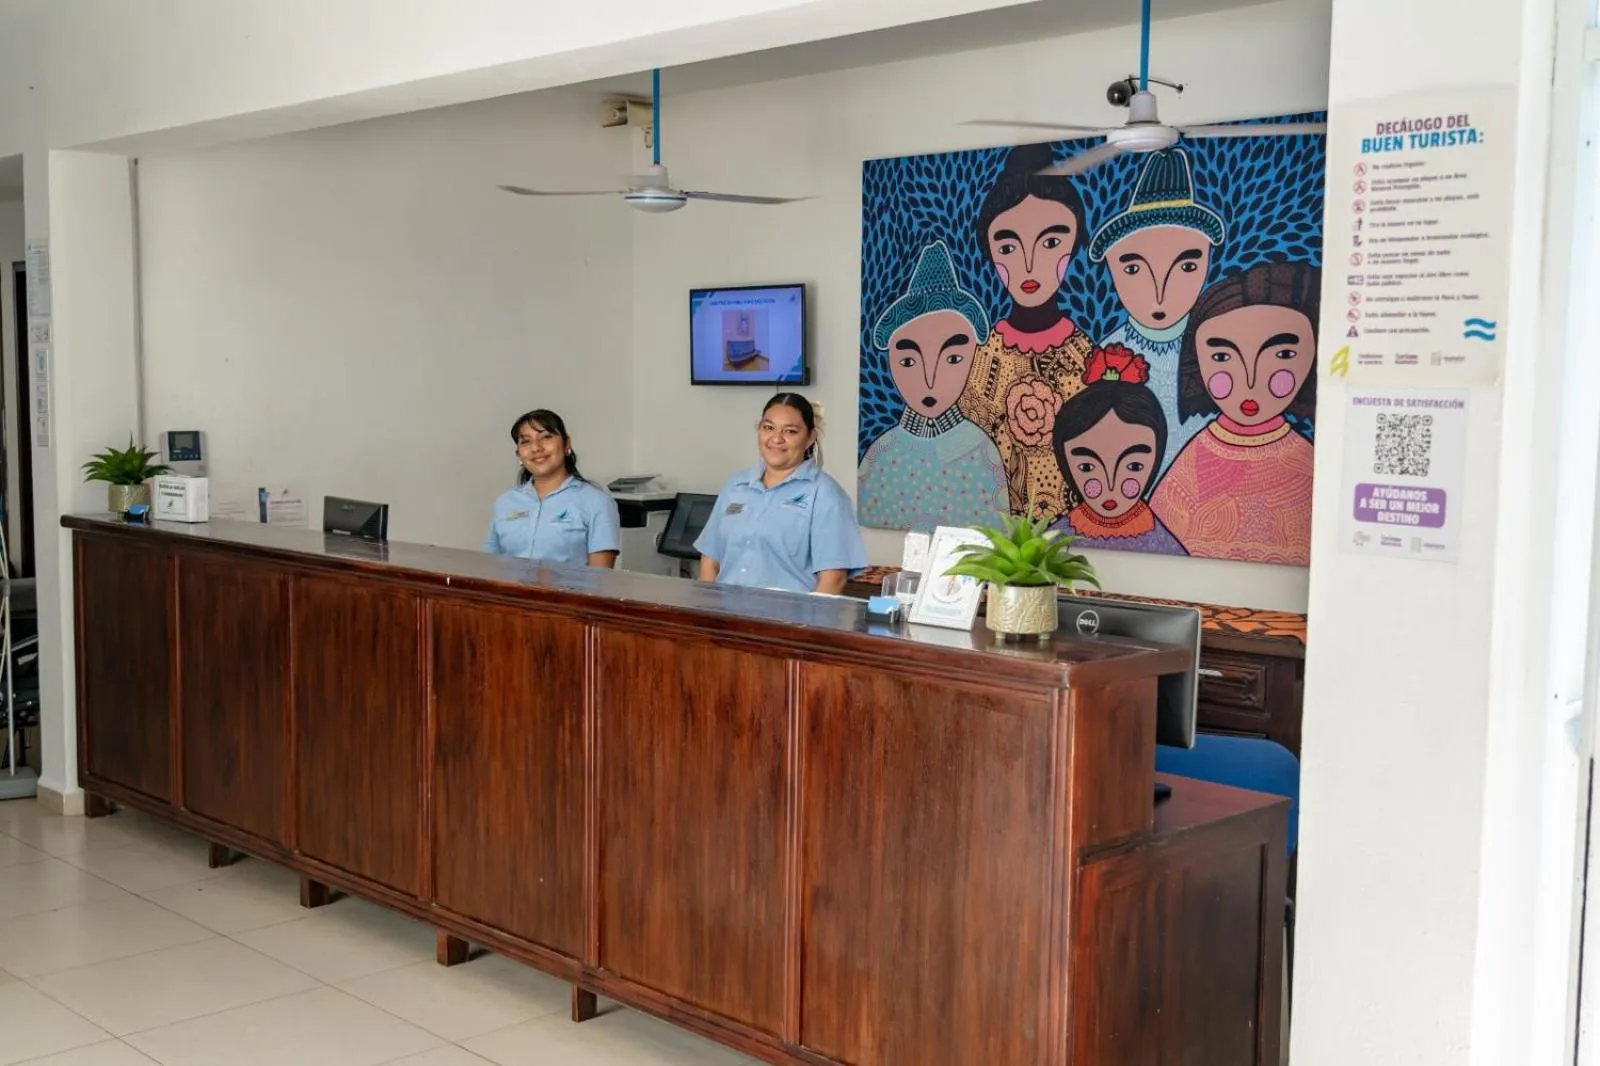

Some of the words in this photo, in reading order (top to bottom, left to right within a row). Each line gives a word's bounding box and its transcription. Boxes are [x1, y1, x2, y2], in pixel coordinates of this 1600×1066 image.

[1376, 117, 1442, 135] DECÁLOGO
[1447, 114, 1470, 128] DEL
[1361, 135, 1403, 154] BUEN
[1410, 128, 1484, 149] TURISTA:
[1352, 396, 1392, 407] ENCUESTA
[1393, 397, 1405, 407] DE
[1406, 397, 1465, 409] SATISFACCIÓN
[1372, 486, 1428, 501] AYÚDANOS
[1359, 498, 1367, 509] A
[1369, 499, 1387, 510] SER
[1389, 501, 1404, 511] UN
[1406, 502, 1440, 514] MEJOR
[1377, 511, 1420, 525] DESTINO
